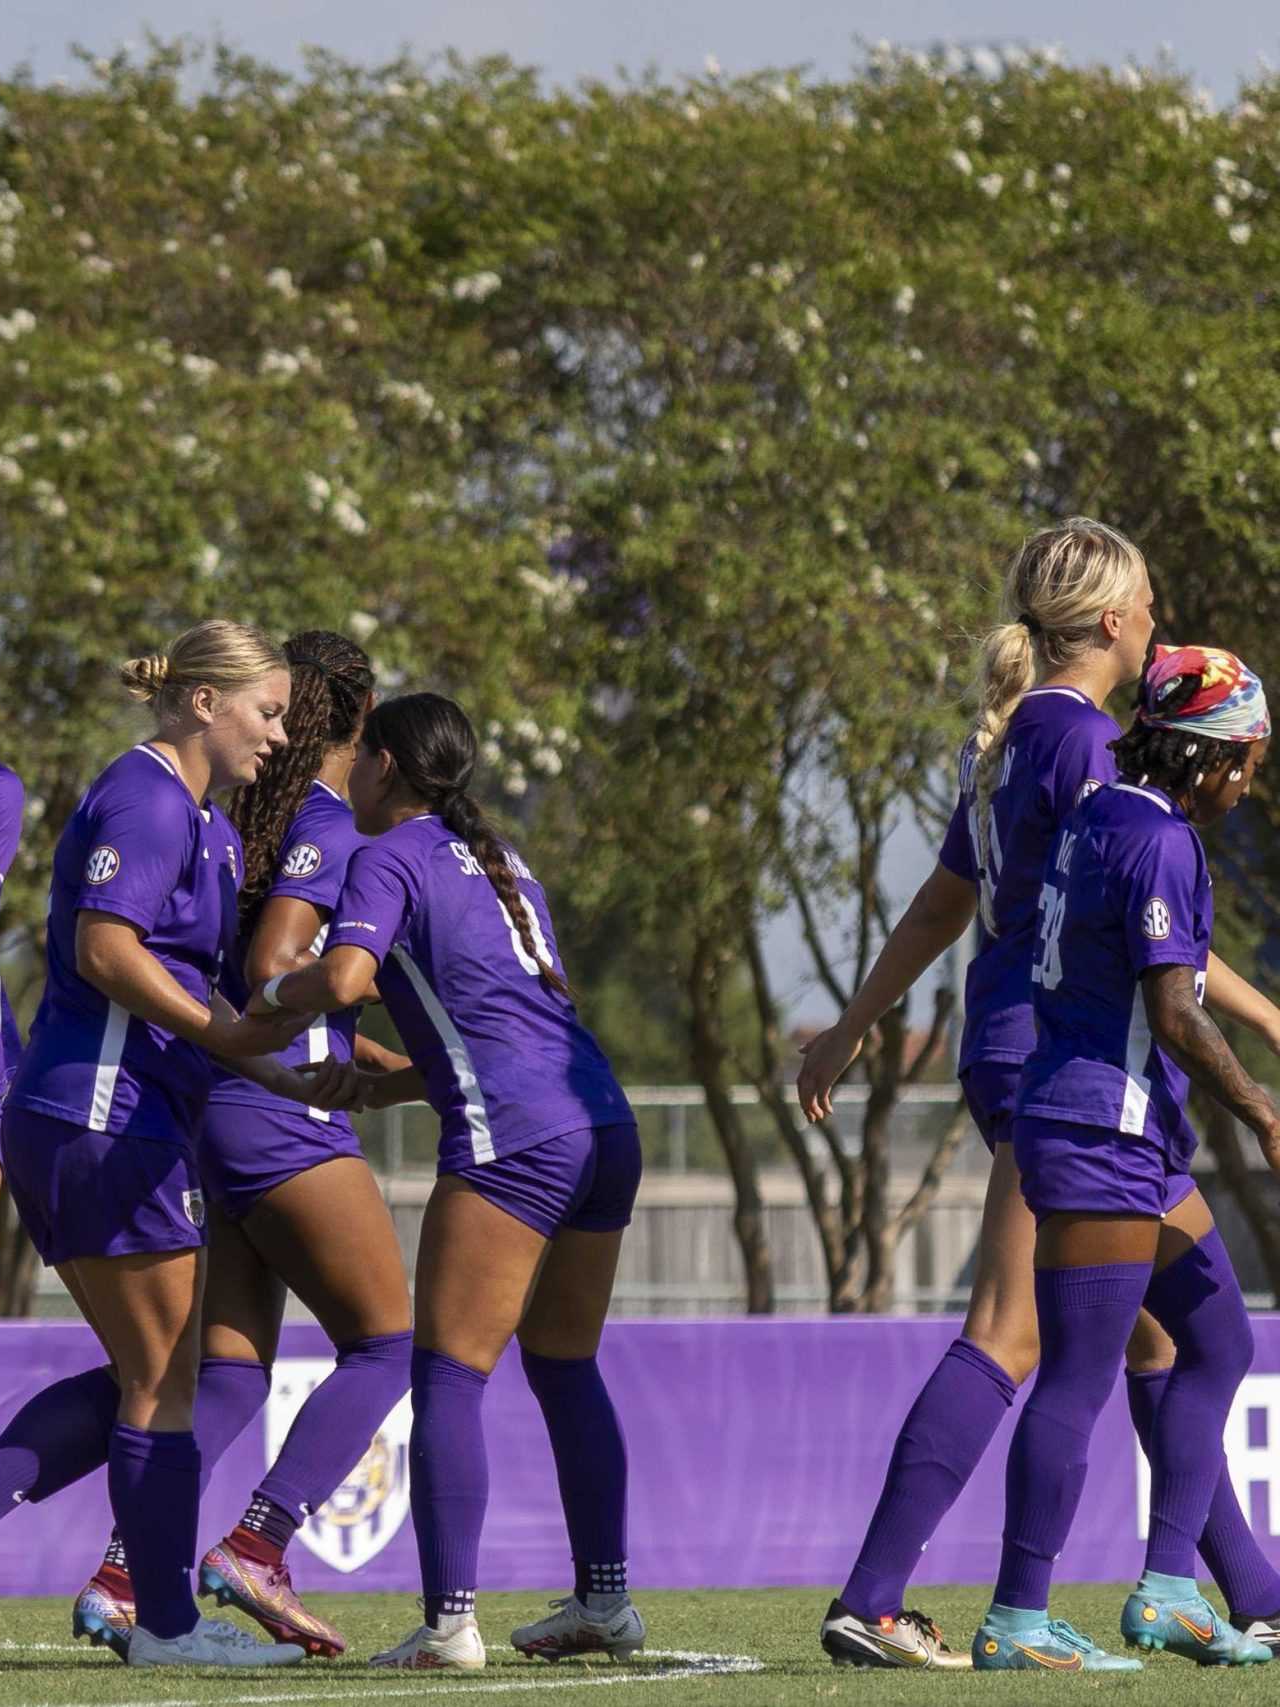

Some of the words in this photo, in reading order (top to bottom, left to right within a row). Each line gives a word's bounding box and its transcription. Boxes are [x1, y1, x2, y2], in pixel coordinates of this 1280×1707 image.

[87, 848, 118, 882] SEC
[284, 846, 320, 877] SEC
[1144, 901, 1169, 936] SEC
